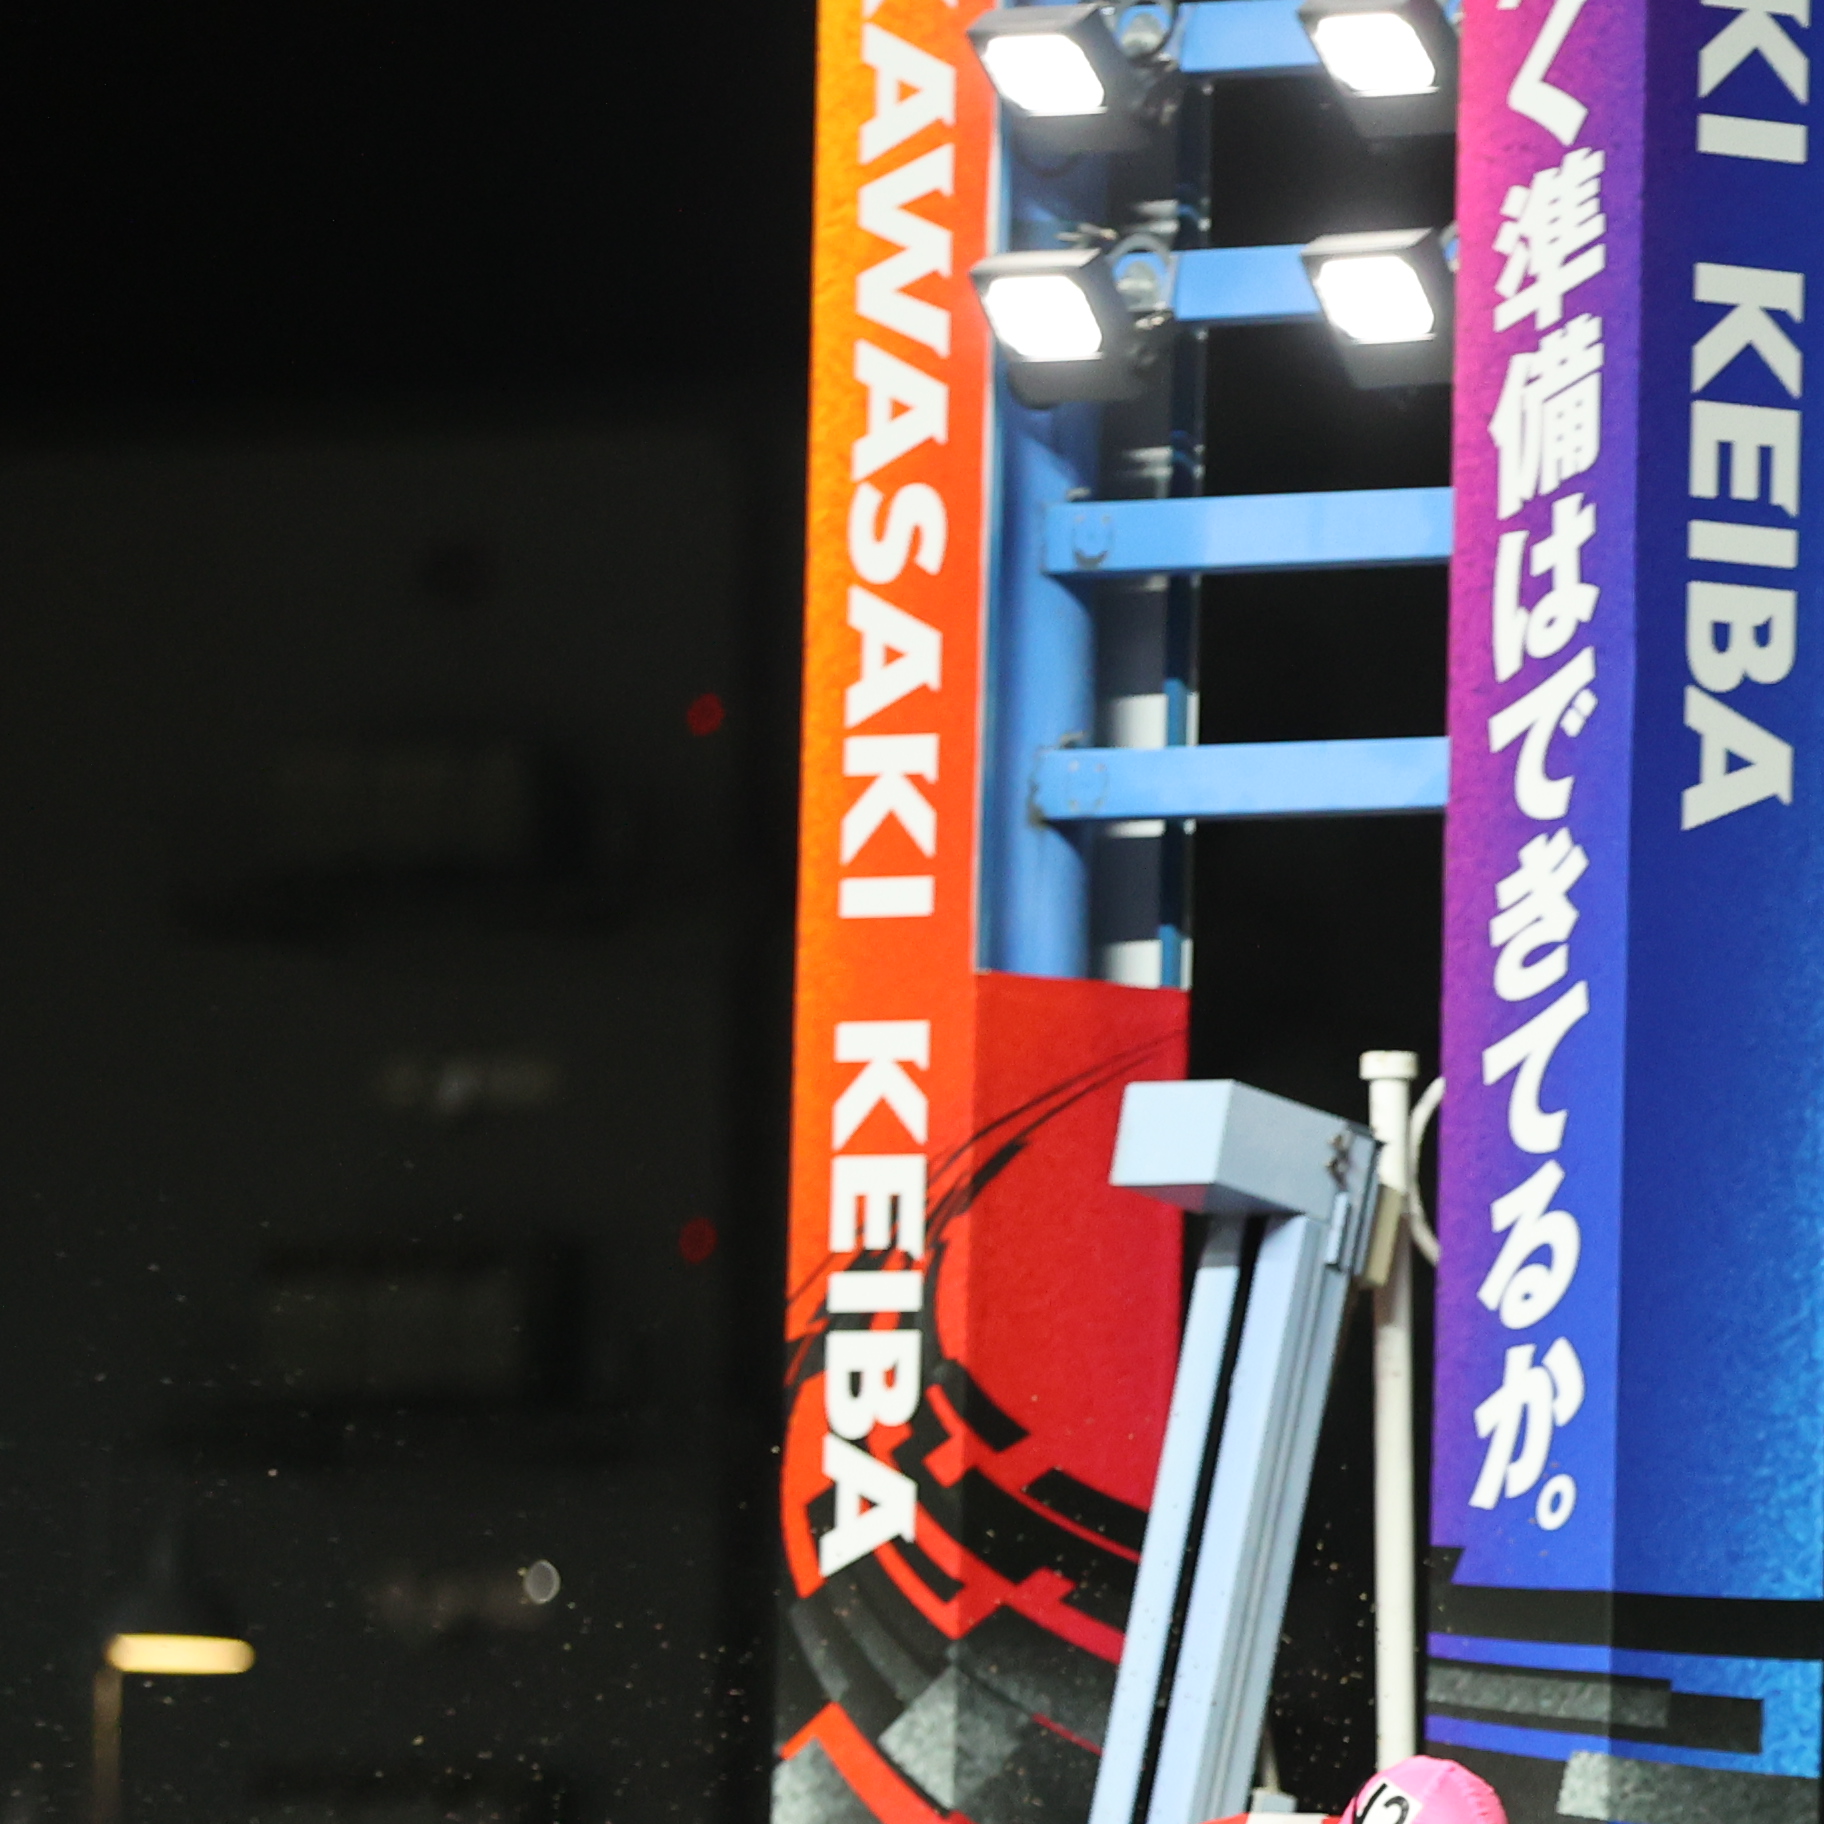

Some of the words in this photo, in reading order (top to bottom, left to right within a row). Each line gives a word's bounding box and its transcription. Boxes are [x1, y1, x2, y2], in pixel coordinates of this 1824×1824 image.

[841, 0, 955, 918] AWASAKI
[1470, 0, 1606, 1530] く準備はできてるか。
[1681, 262, 1805, 831] KEIBA
[819, 1021, 929, 1577] KEIBA
